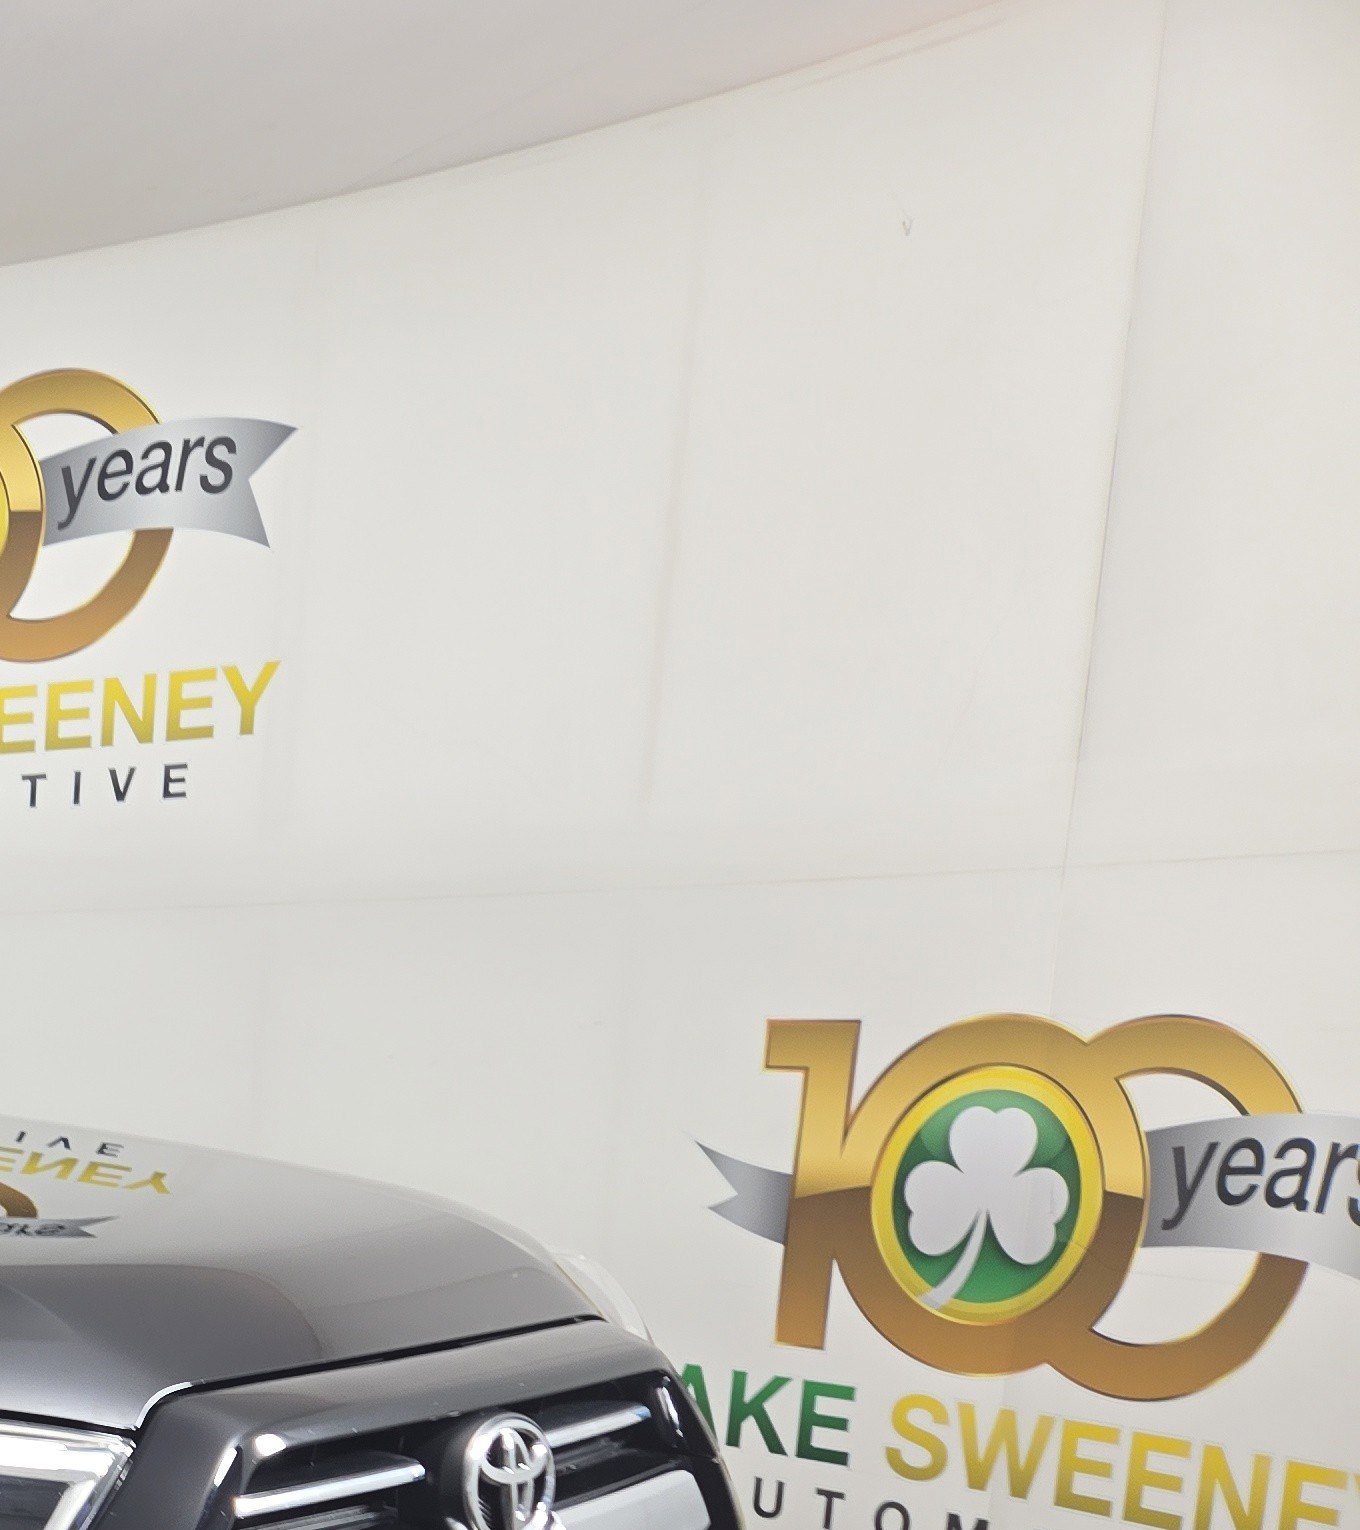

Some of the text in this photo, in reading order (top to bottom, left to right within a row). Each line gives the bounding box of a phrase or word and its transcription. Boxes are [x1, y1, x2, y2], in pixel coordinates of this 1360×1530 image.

[58, 435, 238, 531] years
[763, 1012, 1309, 1402] 100
[679, 1363, 857, 1468] AKE
